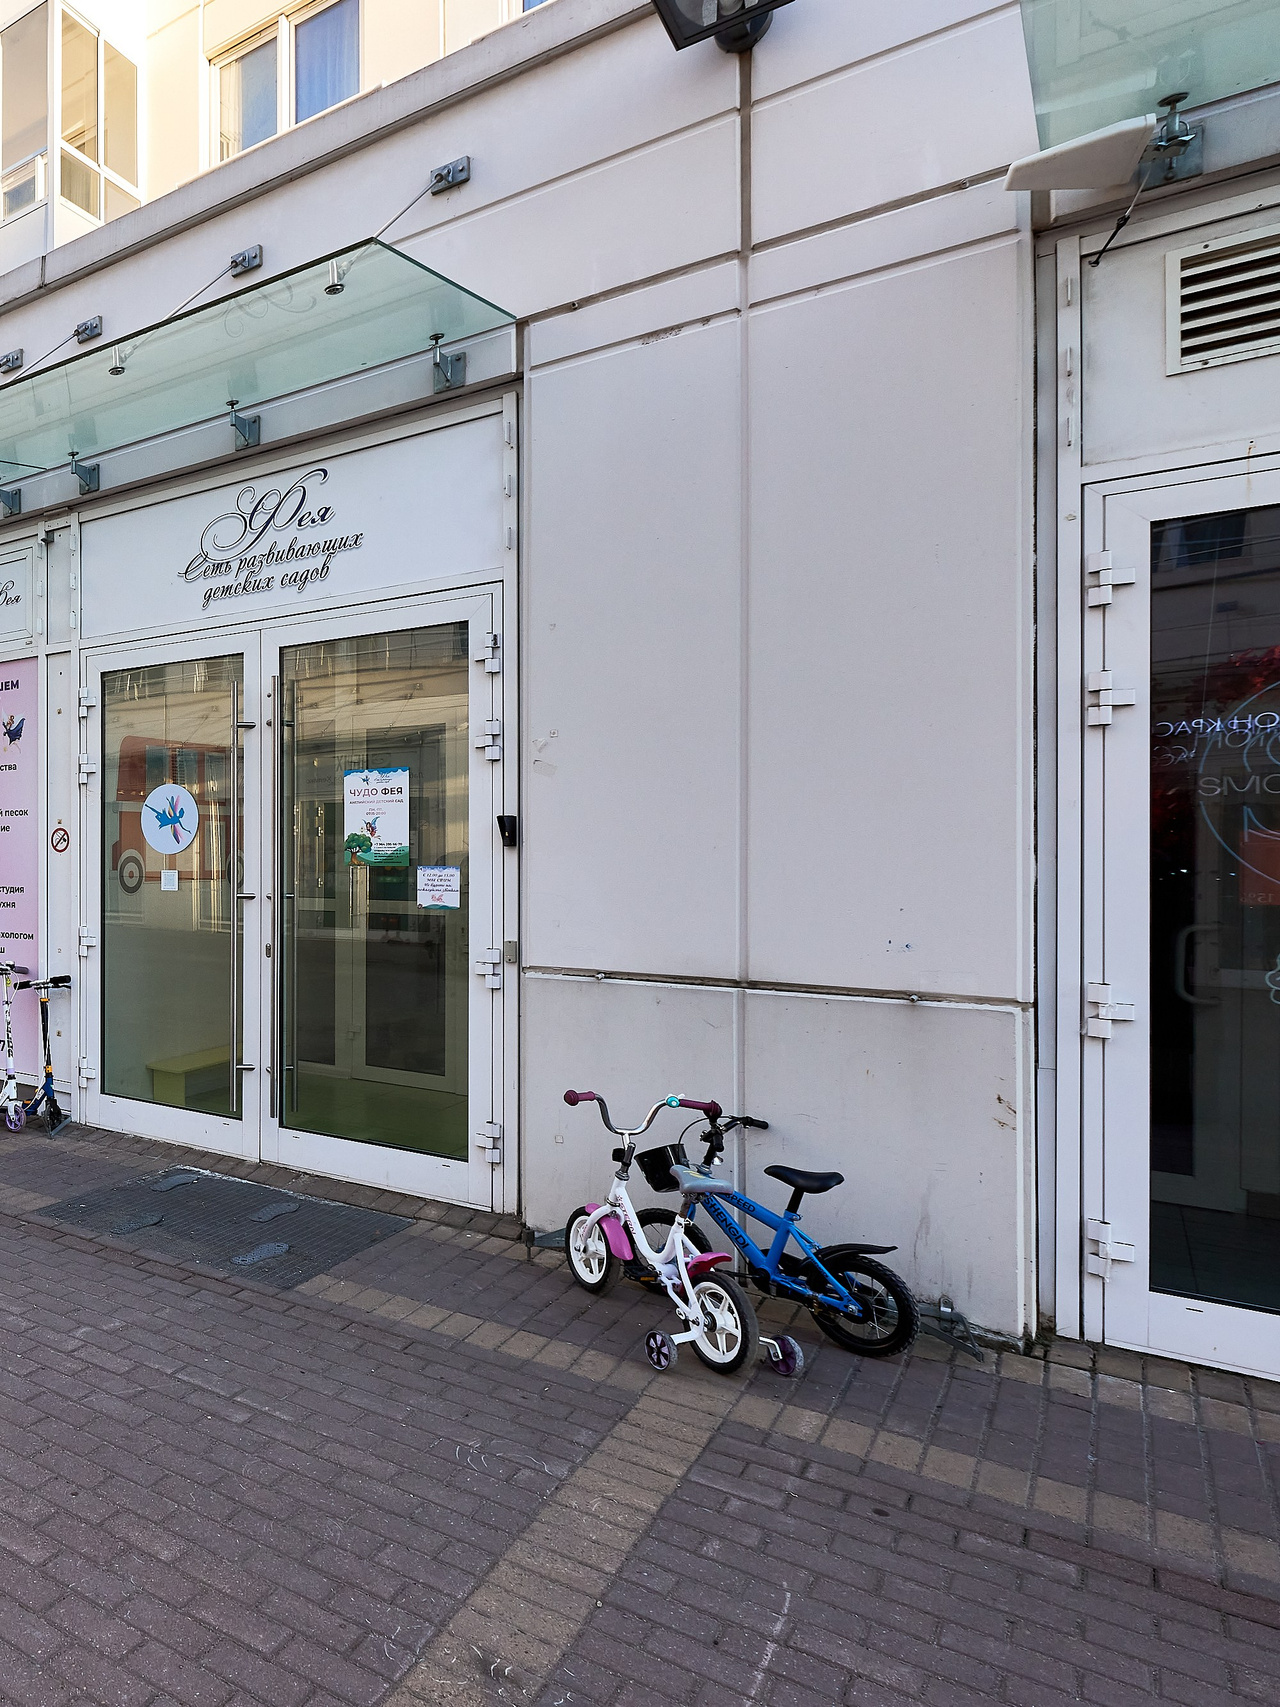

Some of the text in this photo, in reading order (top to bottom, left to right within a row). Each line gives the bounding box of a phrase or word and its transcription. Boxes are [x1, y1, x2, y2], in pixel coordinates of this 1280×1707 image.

[201, 468, 335, 562] Фея
[178, 532, 364, 582] Сеть развивающих
[202, 553, 332, 609] детских садов
[4, 809, 29, 817] песок
[349, 787, 403, 797] ЧУДО ФЕЯ
[0, 1039, 6, 1051] 7
[704, 1197, 749, 1249] SHENGDI
